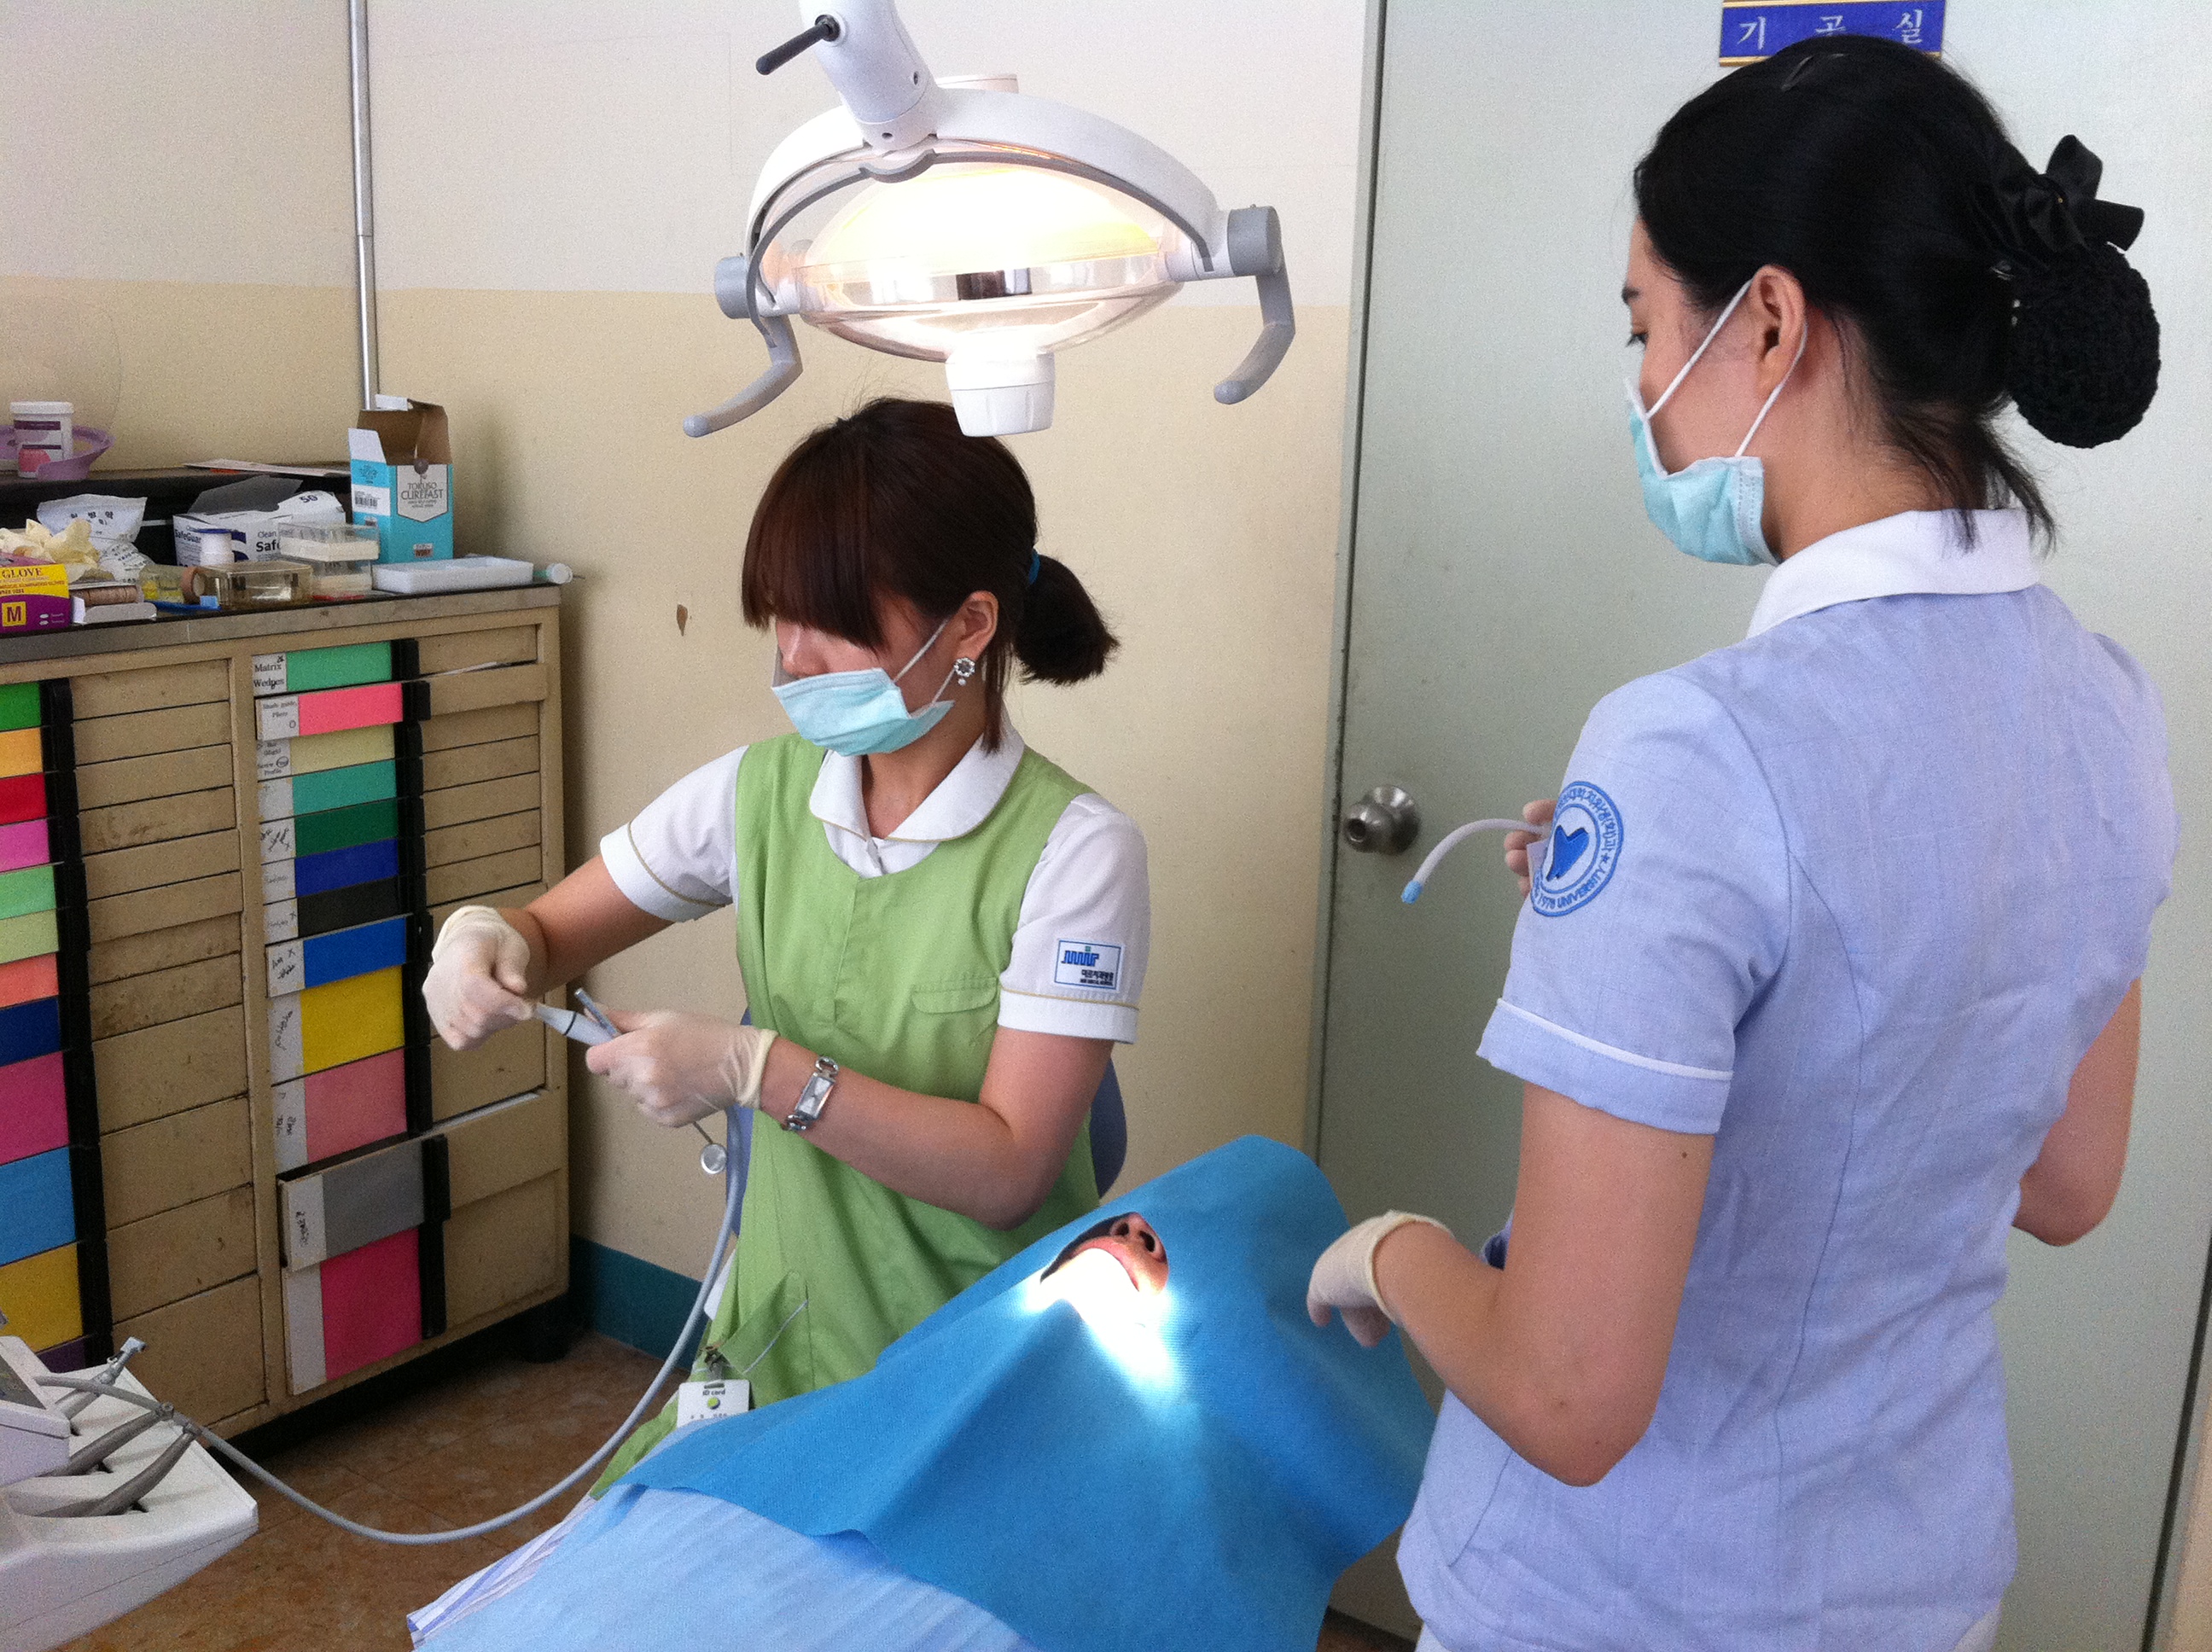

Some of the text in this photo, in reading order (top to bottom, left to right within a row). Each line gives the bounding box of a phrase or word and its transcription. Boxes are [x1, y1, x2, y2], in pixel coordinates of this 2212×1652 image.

[407, 481, 437, 491] TOKUSO
[299, 494, 319, 503] 50
[400, 489, 444, 501] CUREFAST
[174, 529, 202, 544] SafeGuar
[257, 530, 277, 538] Clean
[2, 567, 43, 579] GLOVE
[7, 605, 22, 623] M
[254, 662, 282, 673] Matrix
[253, 677, 285, 690] Wedges
[1557, 862, 1606, 909] UNIVERSITY
